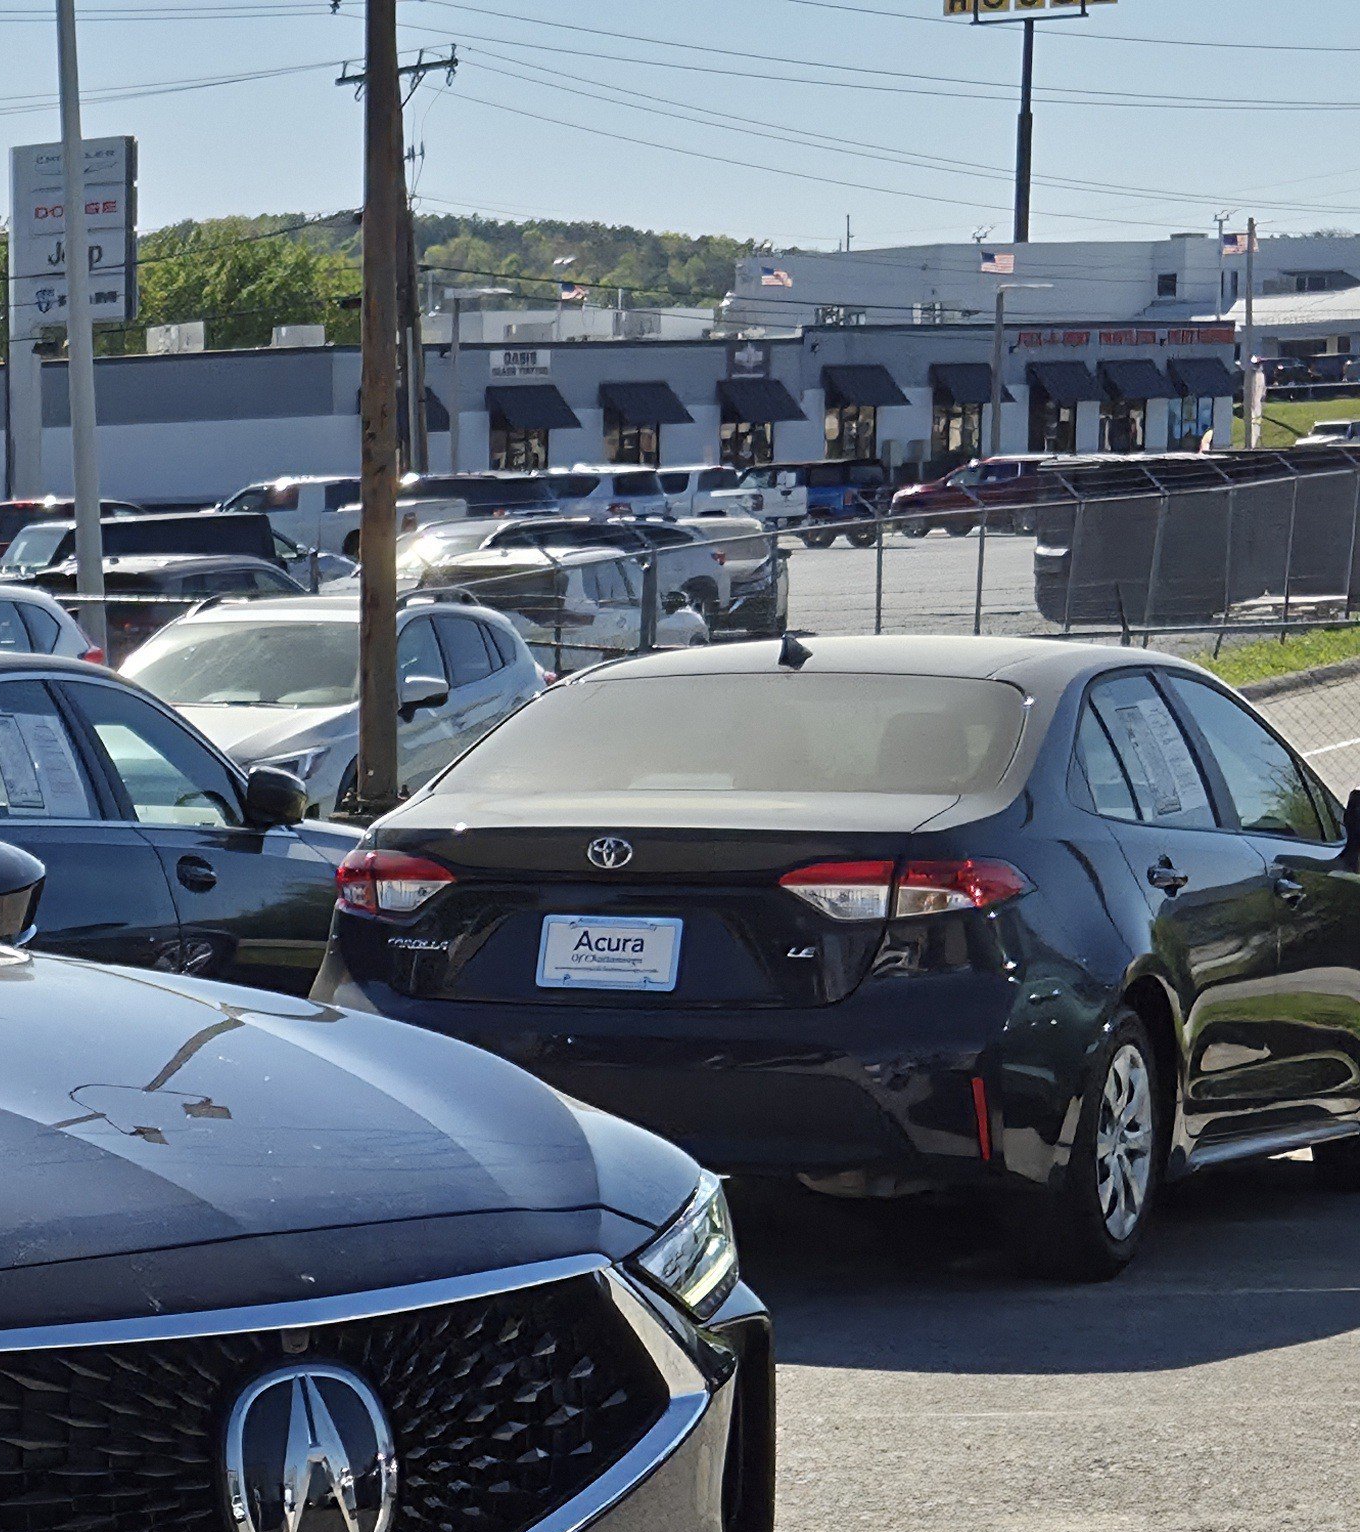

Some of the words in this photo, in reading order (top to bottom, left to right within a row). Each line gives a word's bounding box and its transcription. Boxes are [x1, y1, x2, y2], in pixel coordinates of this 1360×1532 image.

[34, 200, 117, 219] DOGE
[47, 241, 103, 272] Jp
[573, 930, 644, 952] Acura
[787, 946, 816, 958] LE
